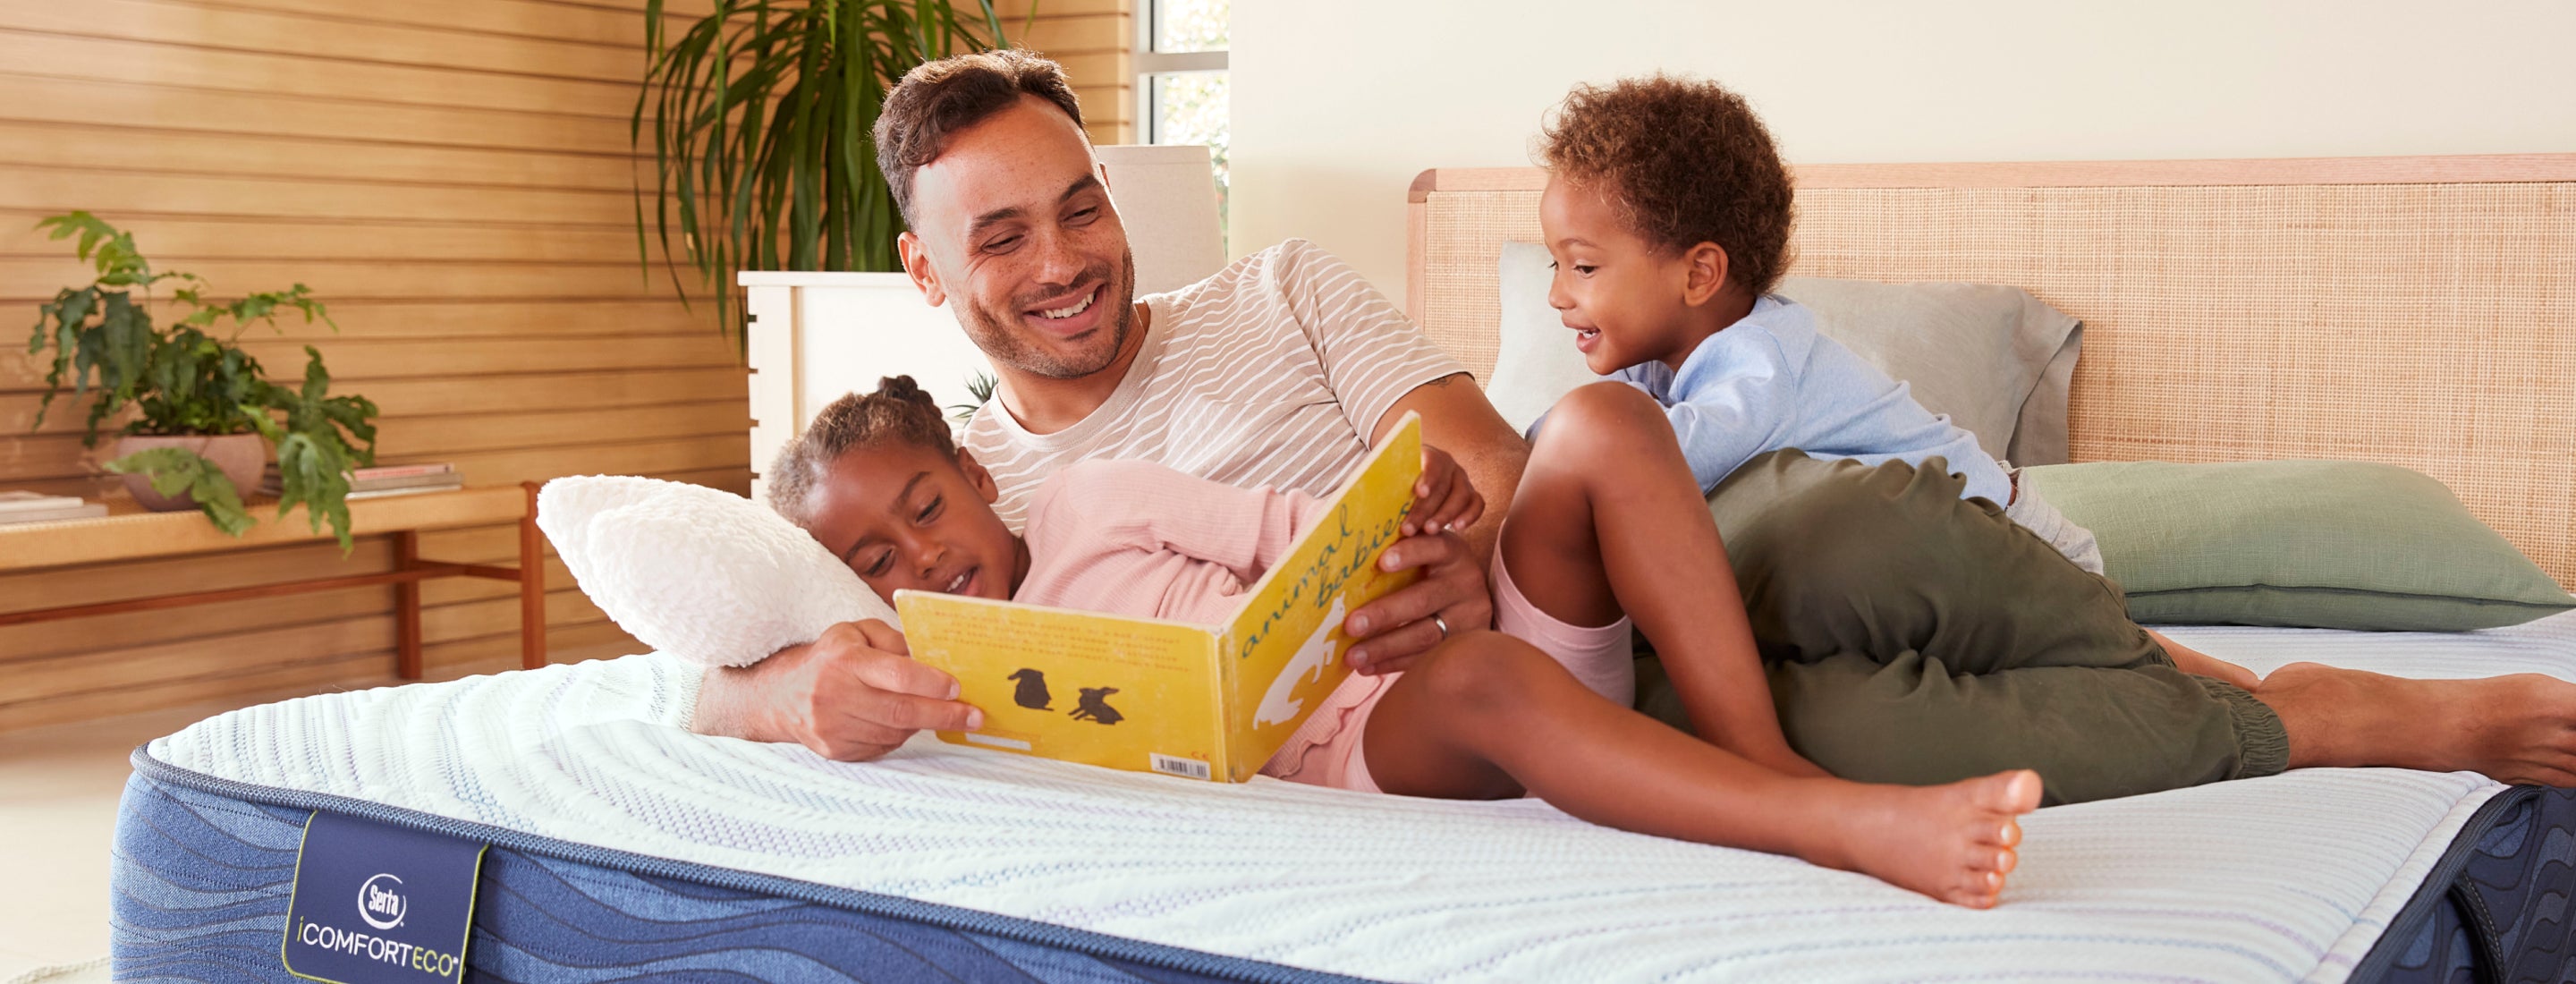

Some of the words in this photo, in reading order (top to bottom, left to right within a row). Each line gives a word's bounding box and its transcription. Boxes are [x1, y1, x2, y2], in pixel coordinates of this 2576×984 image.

[1241, 504, 1352, 658] animal
[1314, 501, 1411, 608] babies
[369, 884, 399, 916] Serta
